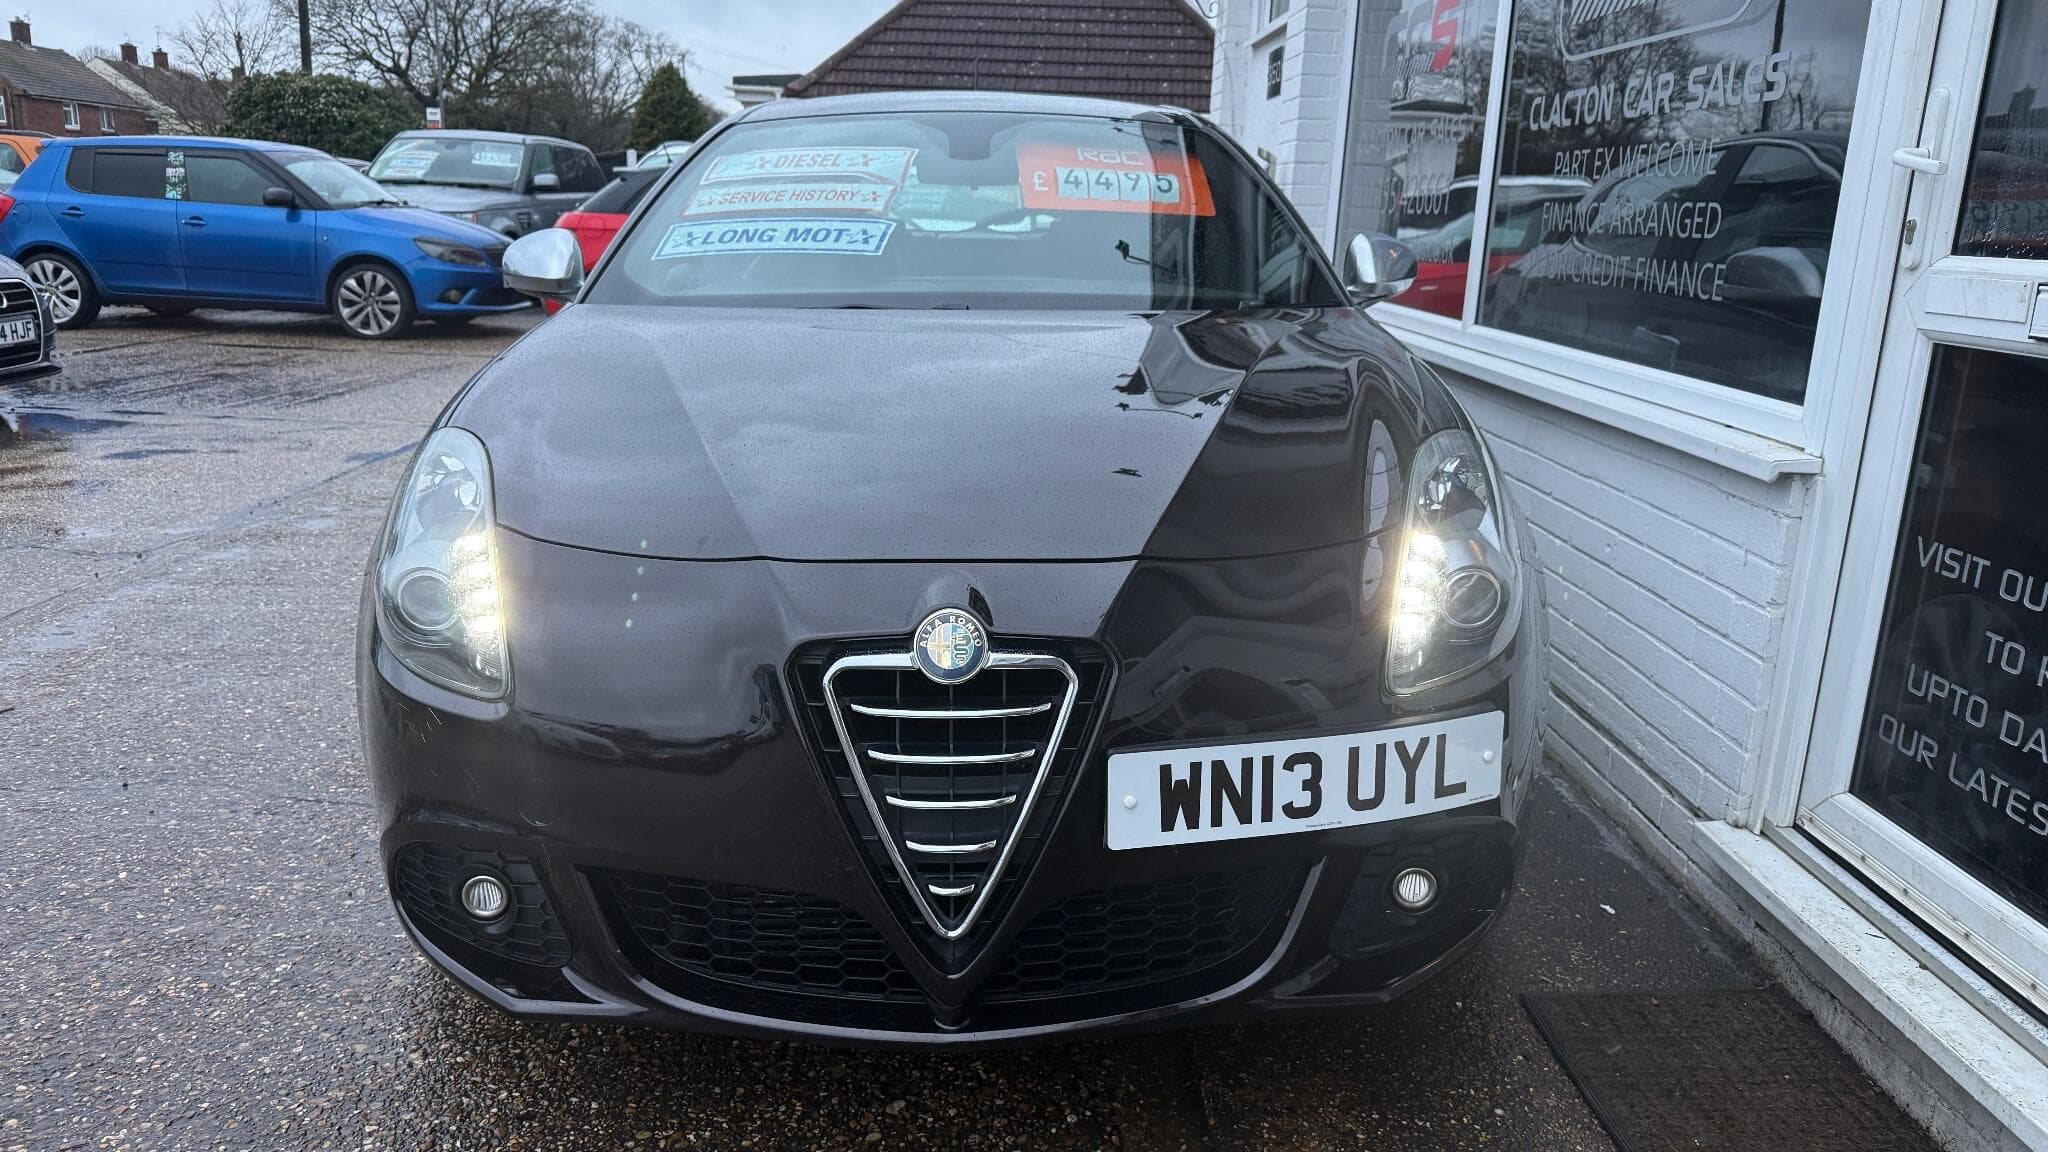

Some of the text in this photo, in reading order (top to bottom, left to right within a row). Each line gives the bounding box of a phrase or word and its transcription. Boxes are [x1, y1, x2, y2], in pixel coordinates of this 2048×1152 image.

[1529, 51, 1789, 131] CLACTON CAR SALES
[1404, 121, 1427, 145] CAR
[1430, 112, 1467, 144] SALES
[772, 153, 841, 168] DIESEL
[1554, 137, 1721, 180] PART EX WELCOME
[717, 189, 860, 205] SERVICE HISTORY
[701, 227, 851, 245] LONG MOT
[1541, 201, 1722, 240] FINANCE ARRANGED
[1571, 252, 1631, 289] CREDIT
[1633, 256, 1727, 301] FINANCE
[10, 319, 32, 341] HJF
[1917, 535, 1991, 589] VISIT
[1985, 630, 2026, 675] TO
[1907, 663, 1989, 728] UPTO
[1878, 713, 1939, 771] OUR
[1160, 733, 1467, 832] WN13 UYL
